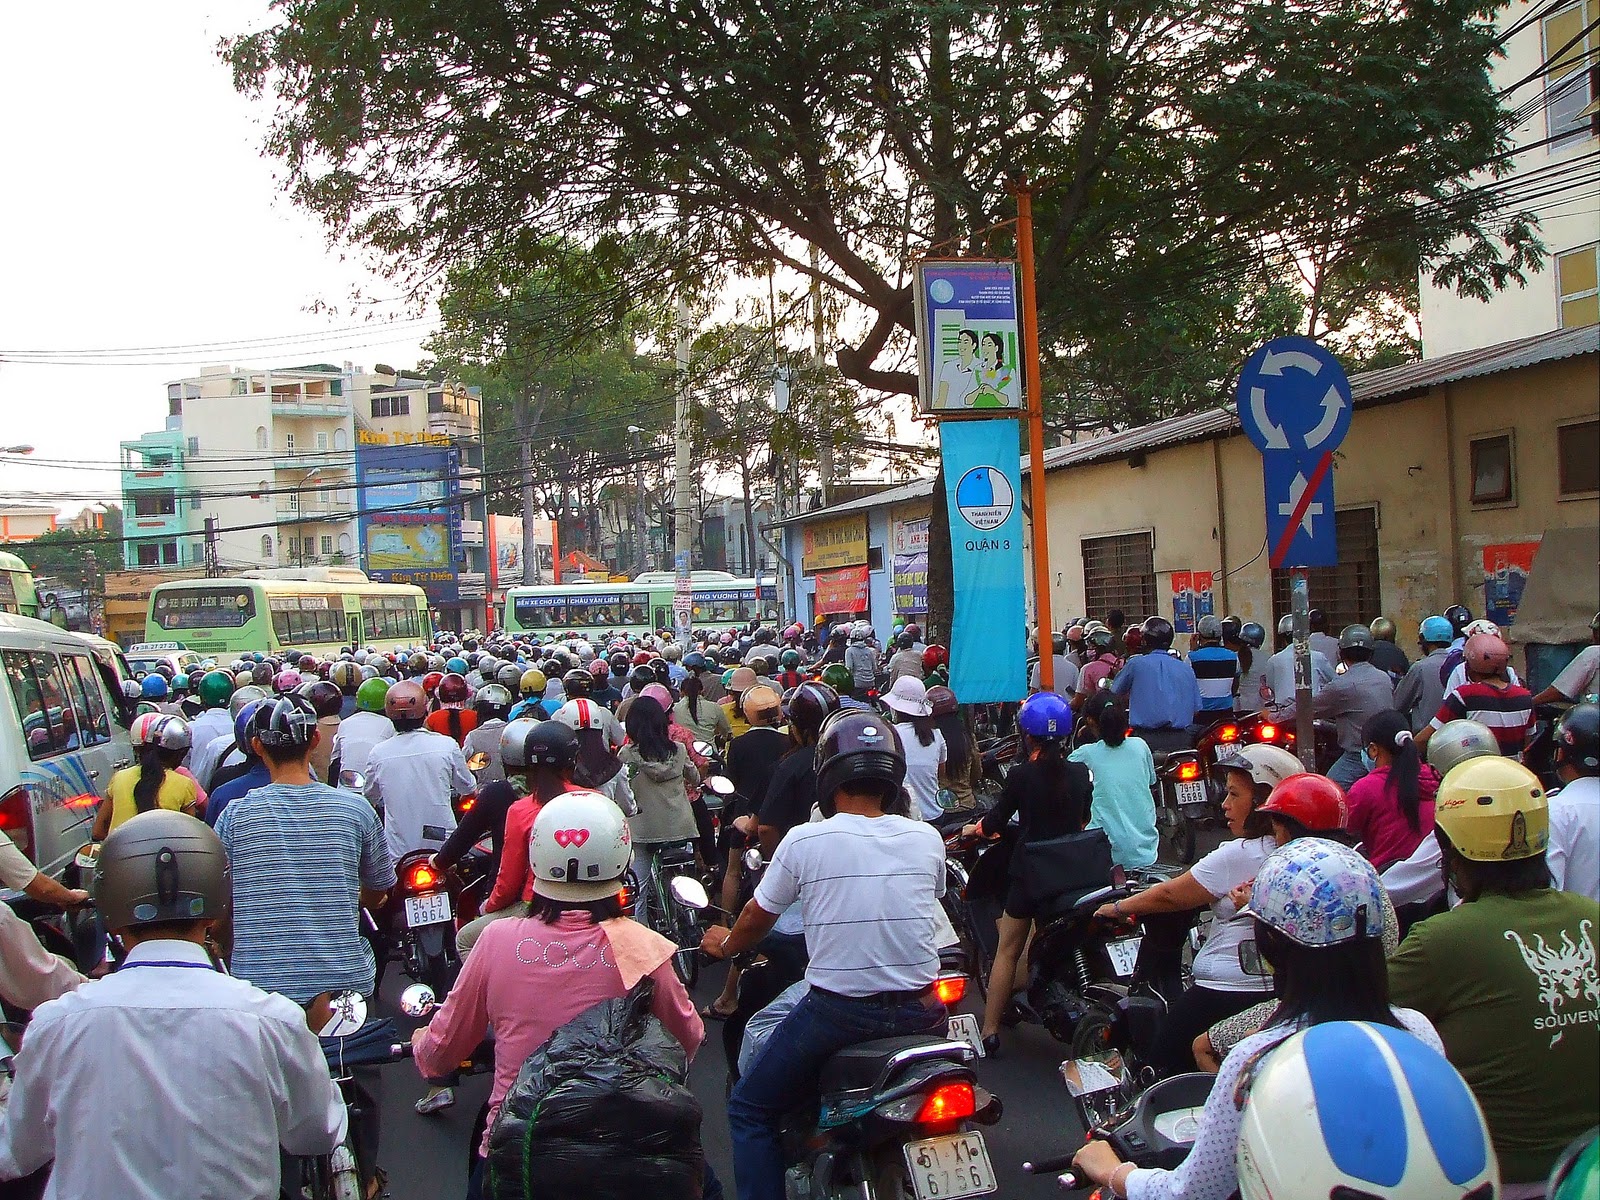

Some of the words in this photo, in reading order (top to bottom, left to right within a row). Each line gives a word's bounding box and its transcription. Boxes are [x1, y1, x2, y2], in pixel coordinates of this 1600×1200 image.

[360, 430, 389, 443] Kim
[965, 538, 999, 552] QUẬN
[1003, 539, 1010, 550] 3
[391, 572, 412, 582] Kim
[692, 592, 711, 600] ÙNG
[412, 896, 443, 911] 54-L3
[413, 908, 444, 924] 8964
[1533, 1009, 1599, 1030] SOUVEN
[927, 1166, 982, 1195] 6756
